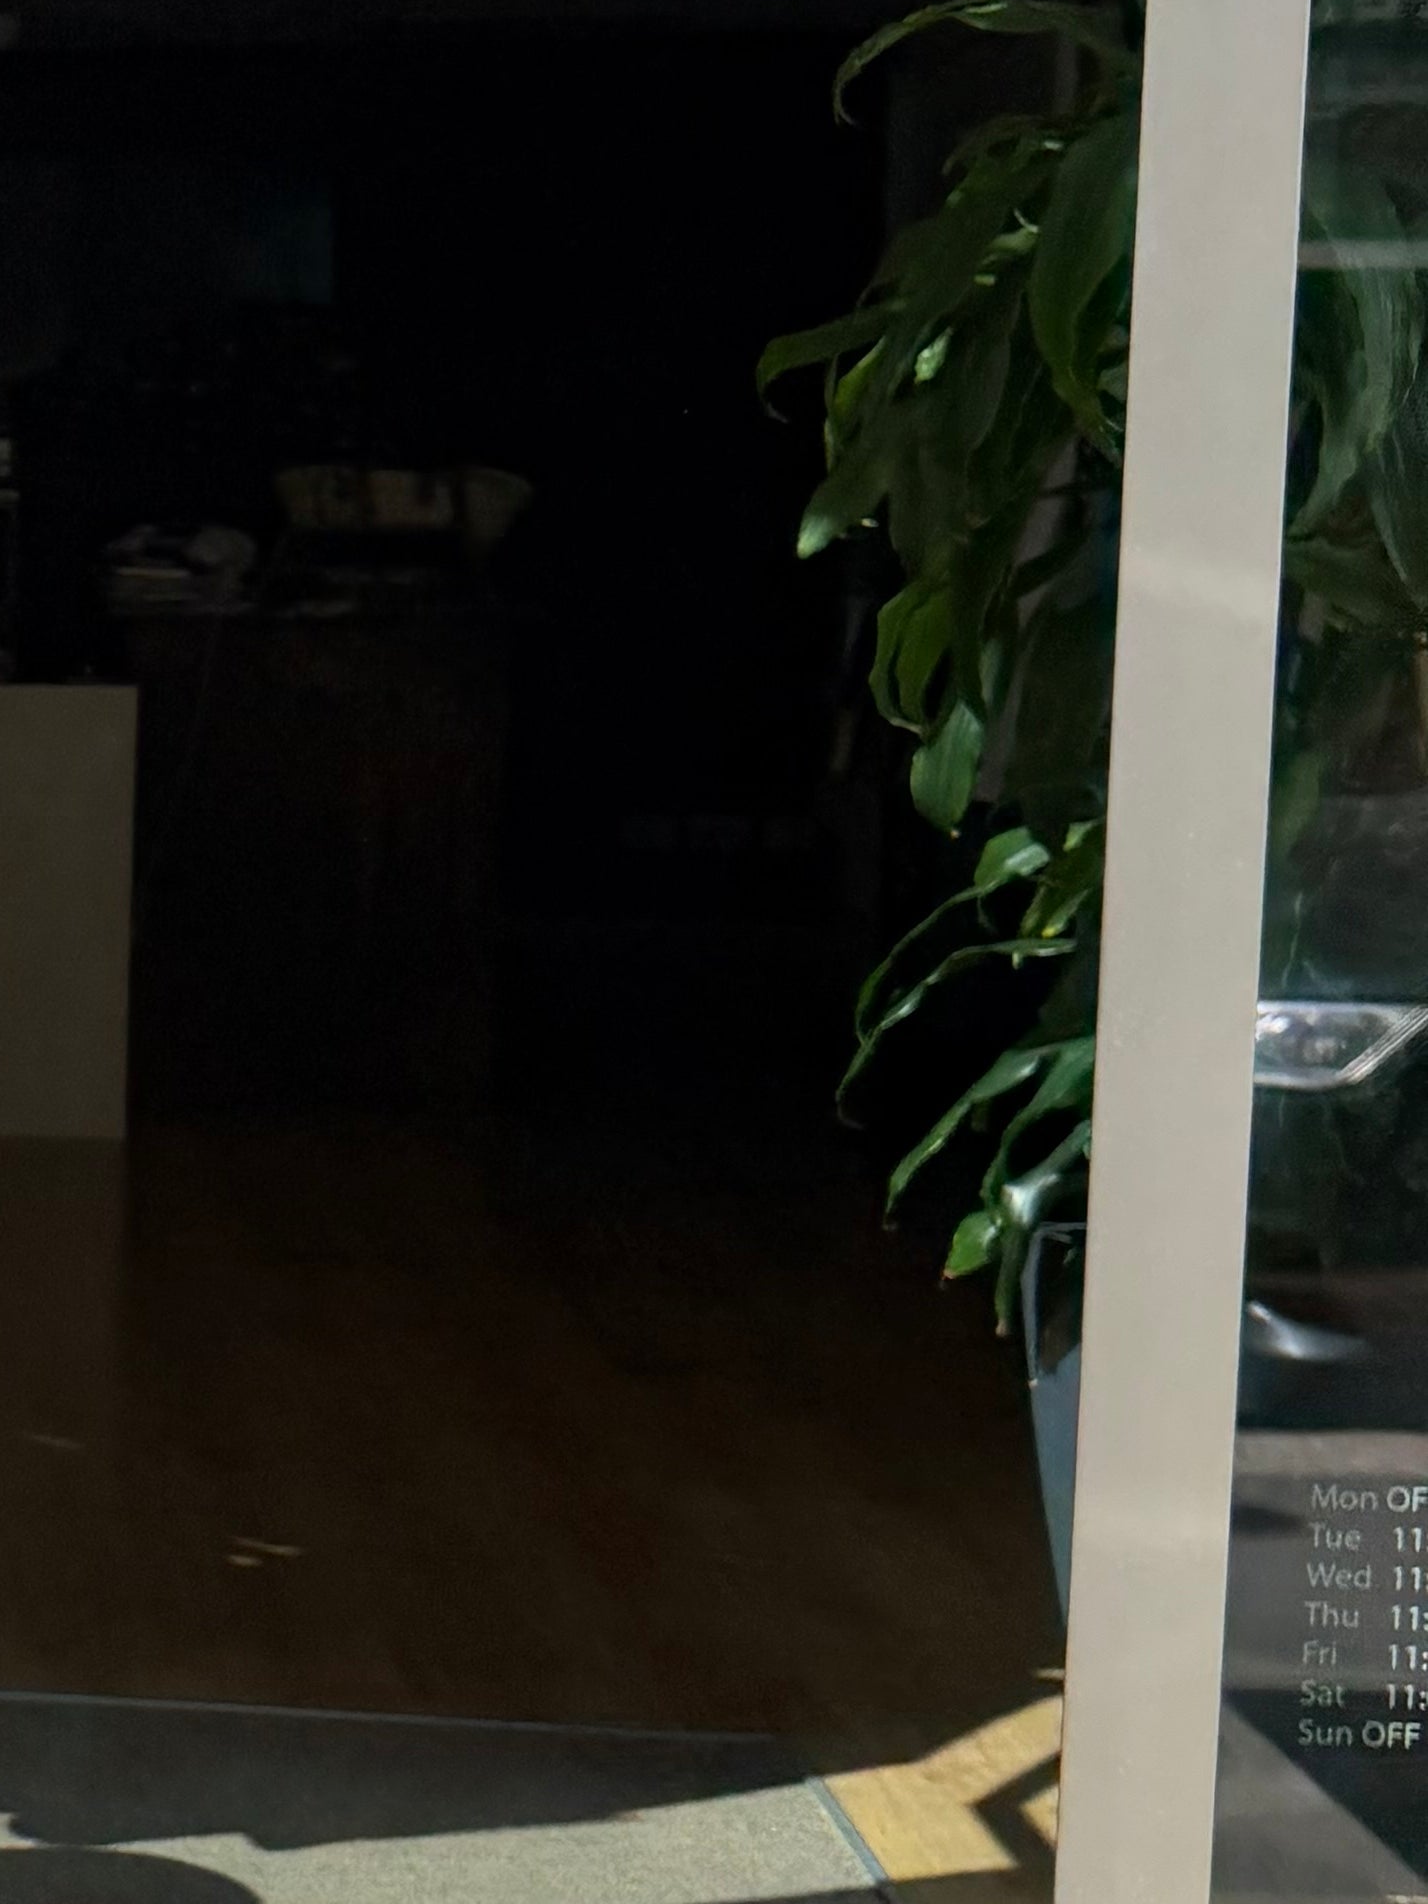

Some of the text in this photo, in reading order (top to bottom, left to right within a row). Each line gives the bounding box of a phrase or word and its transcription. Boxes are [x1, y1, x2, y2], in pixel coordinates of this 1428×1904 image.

[1311, 1483, 1428, 1513] Mon OF
[1308, 1521, 1428, 1553] Tue 11
[1306, 1562, 1372, 1590] Wed
[1304, 1600, 1428, 1631] Thu 11:
[1302, 1640, 1428, 1671] Fri 11:
[1300, 1679, 1428, 1711] Sat 11:
[1297, 1718, 1421, 1749] Sun OFF
